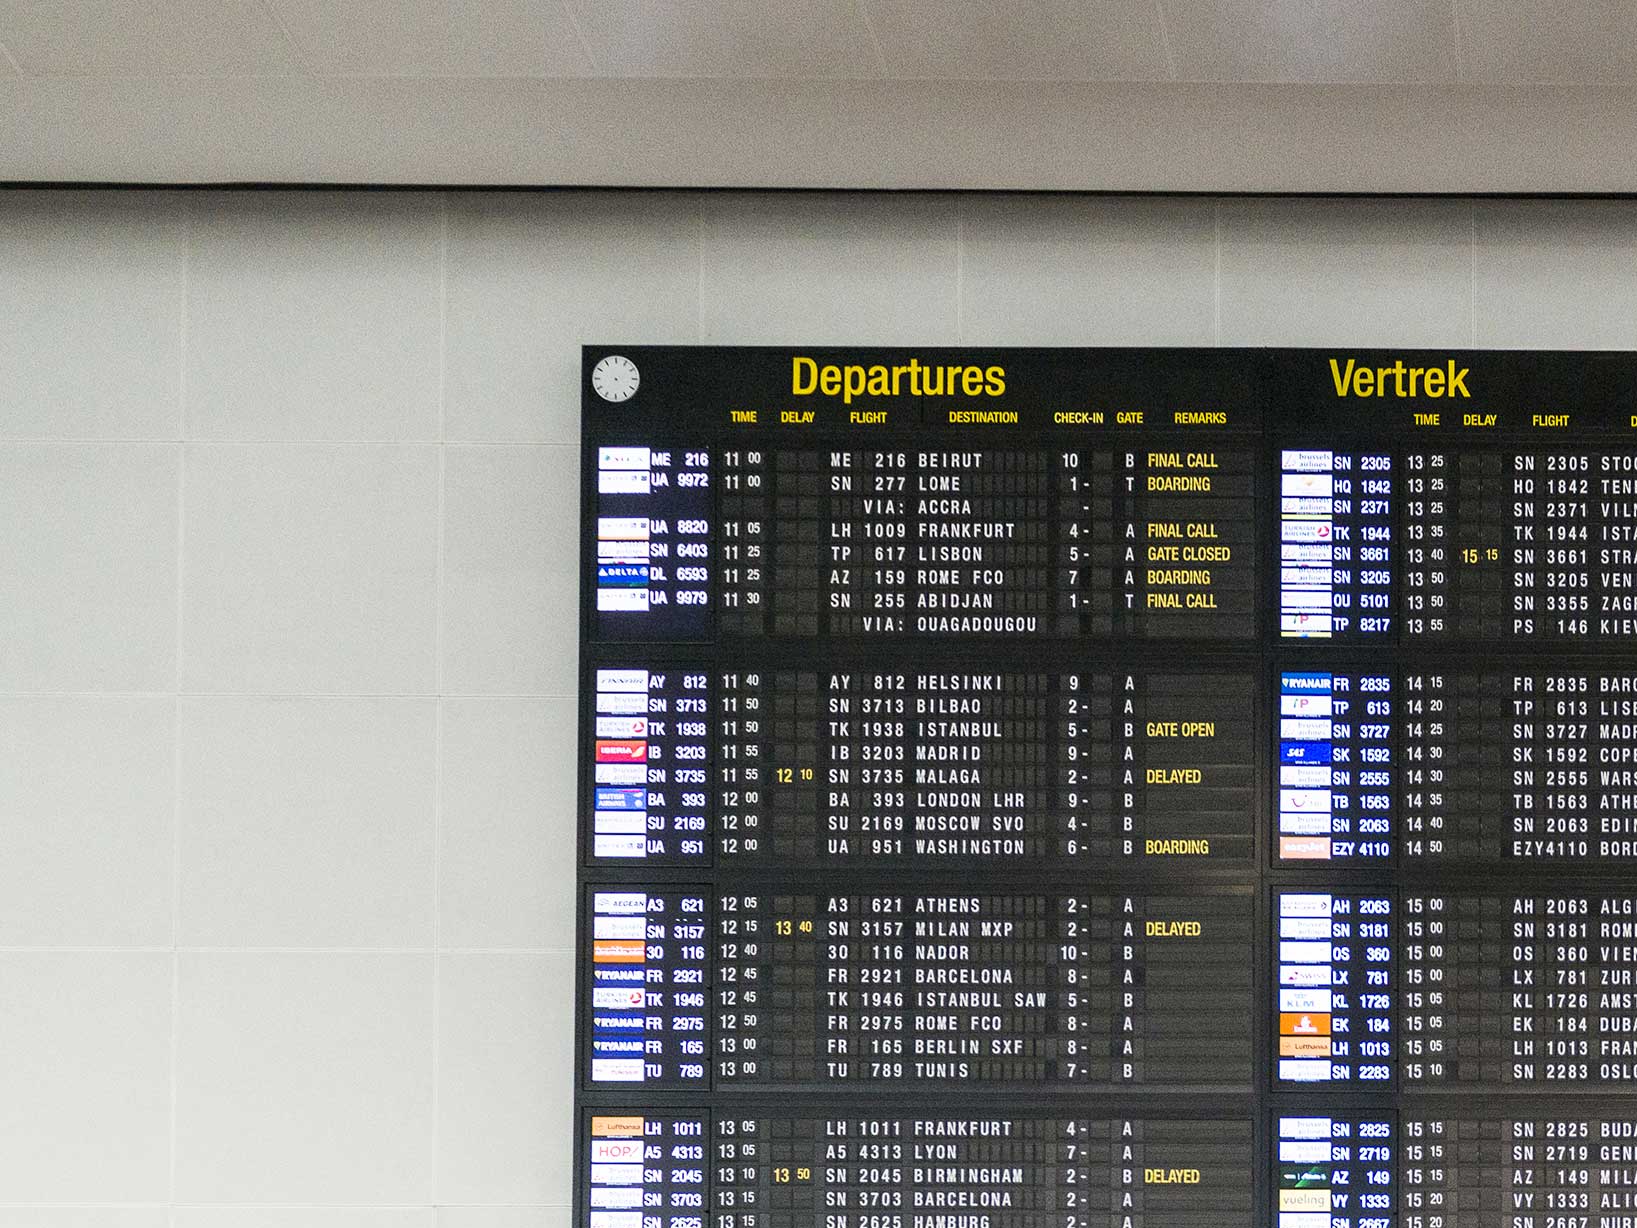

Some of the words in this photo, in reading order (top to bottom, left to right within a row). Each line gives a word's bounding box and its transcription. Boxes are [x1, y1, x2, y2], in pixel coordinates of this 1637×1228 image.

[792, 357, 1006, 403] Departures
[1329, 359, 1471, 397] Vertrek
[730, 410, 757, 423] TIME
[780, 411, 815, 423] DELAY
[850, 411, 888, 424] FLIGHT
[949, 411, 1018, 424] DESTINATION
[1054, 411, 1104, 424] CHECK-IN
[1116, 411, 1144, 424] GATE
[1174, 412, 1227, 424] REMARKS
[1413, 413, 1440, 426] TIME
[1463, 414, 1497, 426] DELAY
[1532, 414, 1570, 427] FLIGHT
[830, 452, 851, 468] ME
[875, 452, 906, 468] 216
[918, 453, 982, 468] BEIRUT
[1148, 453, 1184, 468] FINAL
[1186, 453, 1219, 468] CALL
[919, 476, 960, 491] LOME
[1147, 476, 1211, 492] BOARDING
[918, 522, 1015, 538] FRANKFURT
[1147, 523, 1184, 538] FINAL
[1186, 523, 1218, 538] CALL
[918, 546, 982, 562] LISBON
[1147, 546, 1180, 561] GATE
[1182, 546, 1231, 562] CLOSED
[1513, 549, 1534, 564] SN
[1547, 549, 1586, 564] 3661
[607, 567, 639, 577] DELTA
[1147, 569, 1211, 585] BOARDING
[917, 593, 993, 609] ABIDJAN
[1147, 593, 1183, 608] FINAL
[1186, 593, 1218, 609] CALL
[917, 616, 1036, 632] OUAGADOUGOU
[1288, 678, 1332, 689] RYANAIR
[916, 698, 981, 714] BILBAO
[919, 722, 1002, 738] ISTANBUL
[1146, 722, 1178, 737] GATE
[1181, 722, 1215, 737] OPEN
[600, 746, 633, 755] IBERIA
[915, 768, 981, 784] MALAGA
[1146, 769, 1202, 784] DELAYED
[917, 792, 981, 808] LONDON
[994, 792, 1025, 808] LHR
[915, 839, 1024, 855] WASHINGTON
[1145, 839, 1209, 855] BOARDING
[1513, 840, 1588, 856] EZY4110
[915, 897, 980, 913] ATHENS
[1146, 921, 1201, 937] DELAYED
[915, 945, 969, 960] NADOR
[600, 971, 645, 981] RYANAIR
[915, 968, 1013, 984] BARCELONA
[1286, 999, 1316, 1008] KLM
[915, 1039, 979, 1054] BERLIN
[991, 1039, 1023, 1055] SXF
[606, 1122, 642, 1131] Lufthansa
[914, 1121, 1012, 1136] FRANKFURT
[914, 1144, 957, 1160] LYON
[1144, 1168, 1200, 1184] DELAYED
[914, 1191, 1012, 1207] BARCELONA
[1282, 1195, 1326, 1207] vueling
